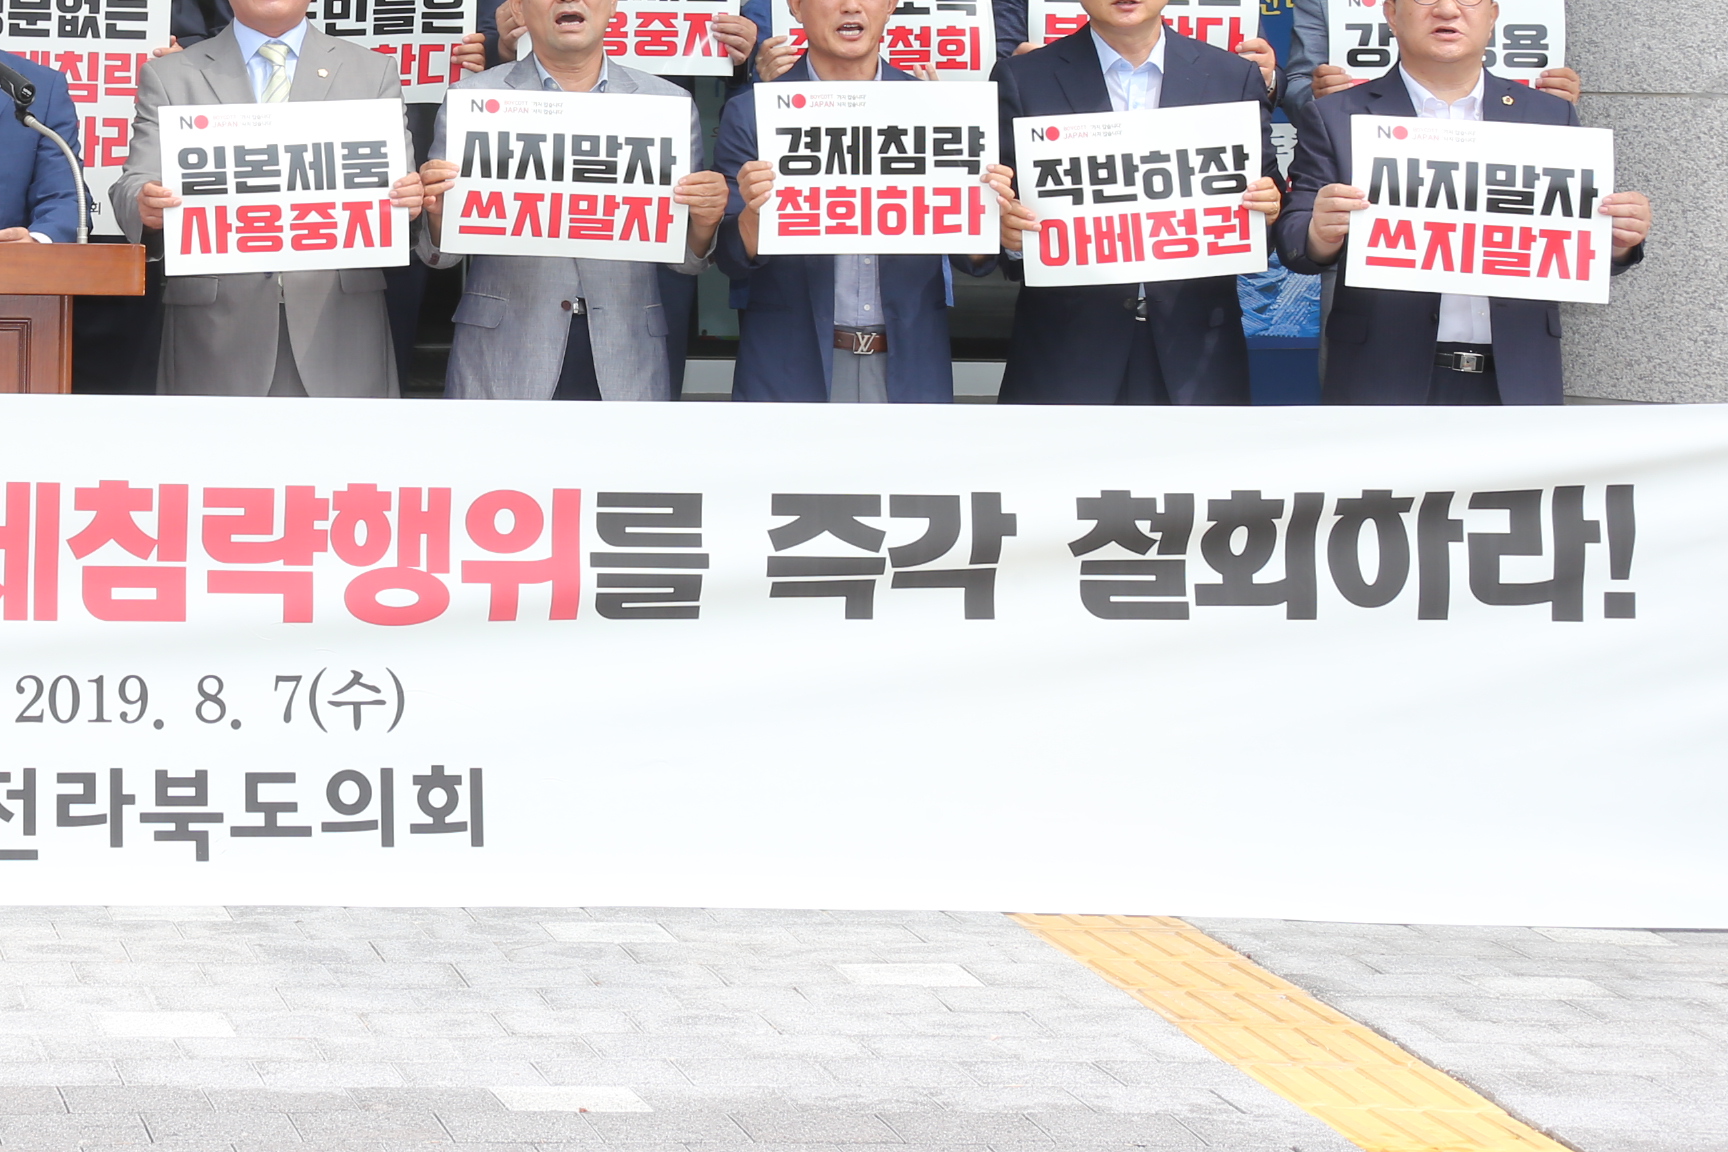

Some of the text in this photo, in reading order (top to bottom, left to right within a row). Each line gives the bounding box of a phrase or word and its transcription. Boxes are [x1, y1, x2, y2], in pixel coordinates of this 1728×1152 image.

[177, 140, 390, 196] 일본제품
[460, 131, 677, 186] 사지말자
[775, 125, 986, 176] 경제침략
[1033, 144, 1249, 206] 적반하장
[458, 190, 674, 244] 쓰지말자
[775, 185, 986, 237] 철회하라
[1368, 157, 1599, 219] 사지말자
[180, 199, 393, 255] 사용중지
[1038, 204, 1252, 267] 아베정권
[1365, 218, 1596, 281] 쓰지말자
[766, 491, 1018, 620] 즉각
[1067, 483, 1637, 623] 철회하라!
[14, 666, 406, 733] 2019. 8. 7(수)
